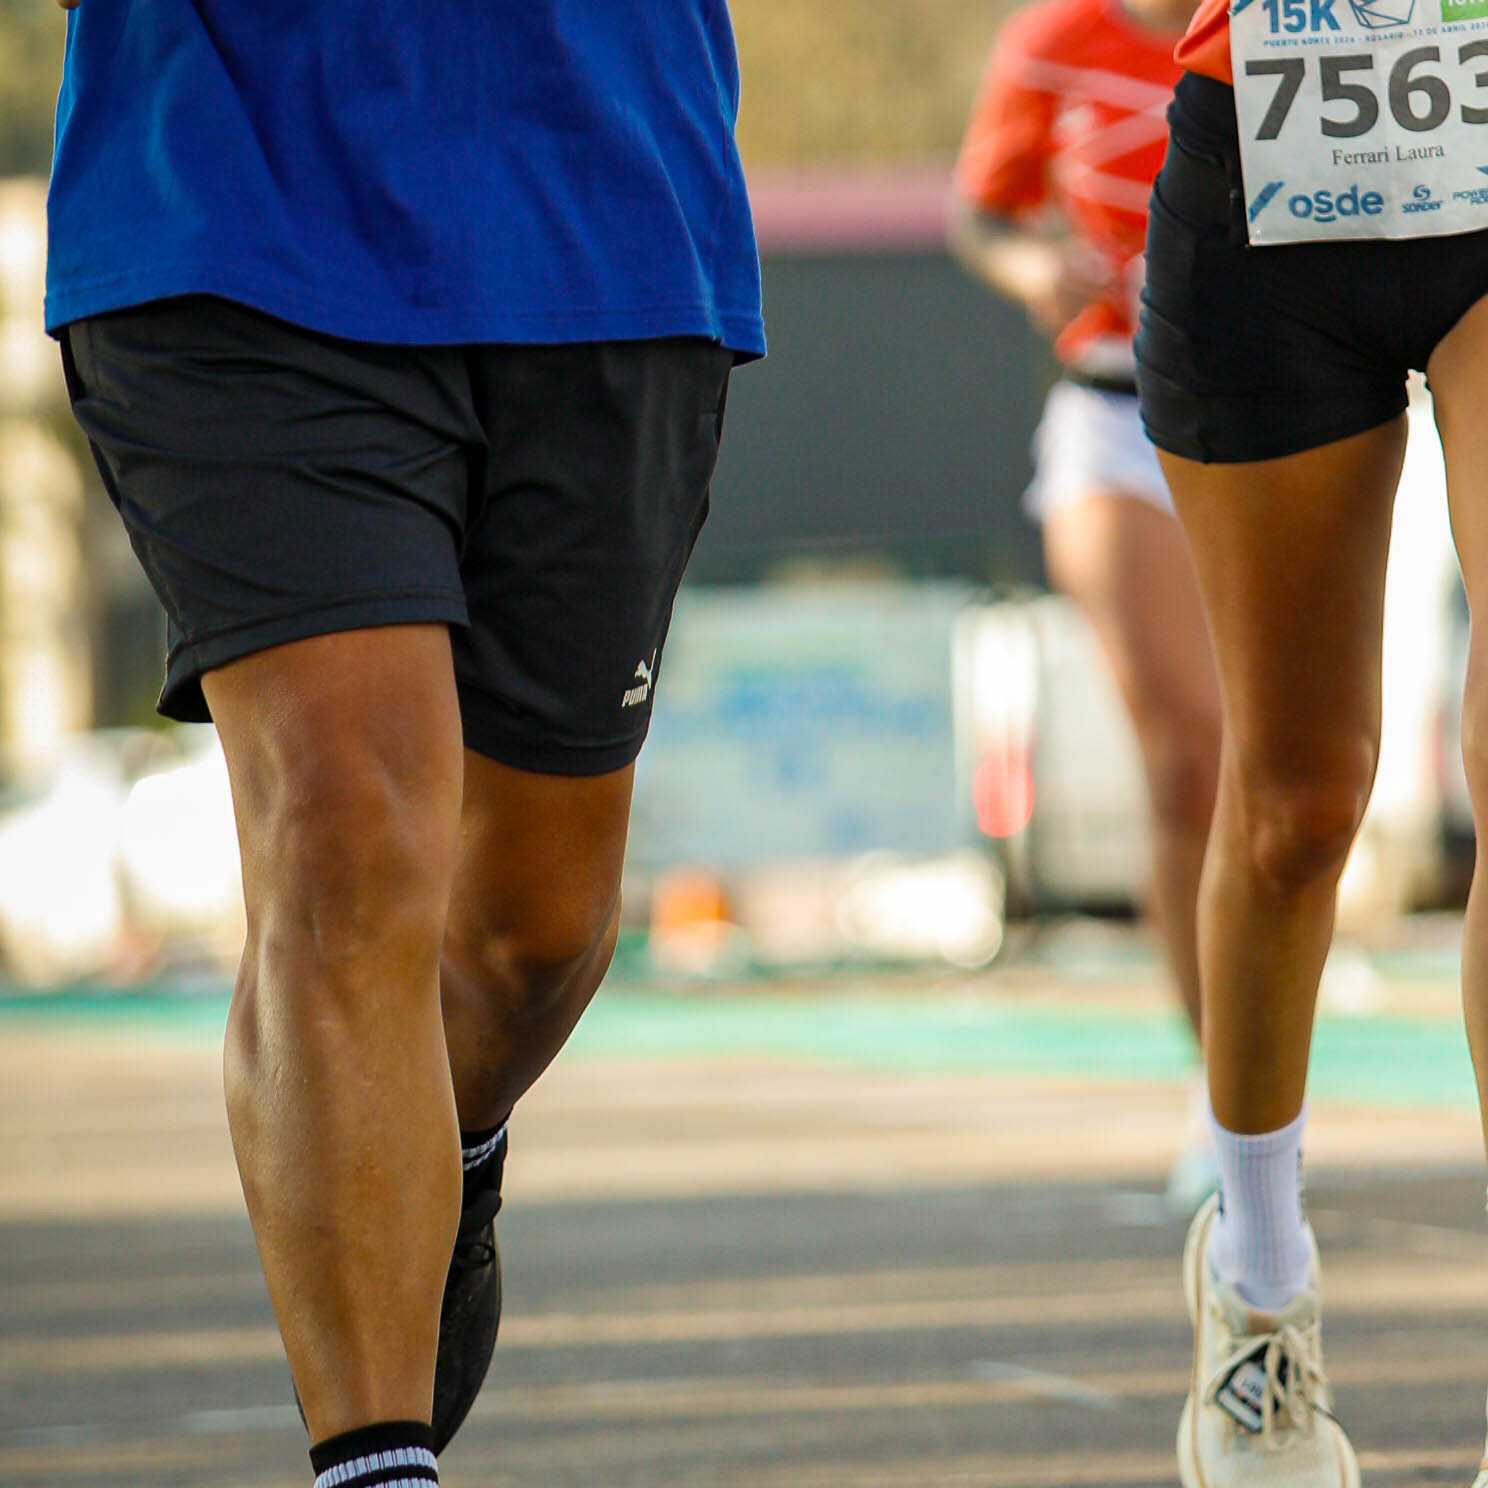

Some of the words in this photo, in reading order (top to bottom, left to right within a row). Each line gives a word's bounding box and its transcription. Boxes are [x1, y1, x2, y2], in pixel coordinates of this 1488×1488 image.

[1332, 145, 1390, 165] Ferrari
[1395, 144, 1445, 161] Laura
[1288, 184, 1385, 221] osde
[621, 683, 648, 708] PUMA
